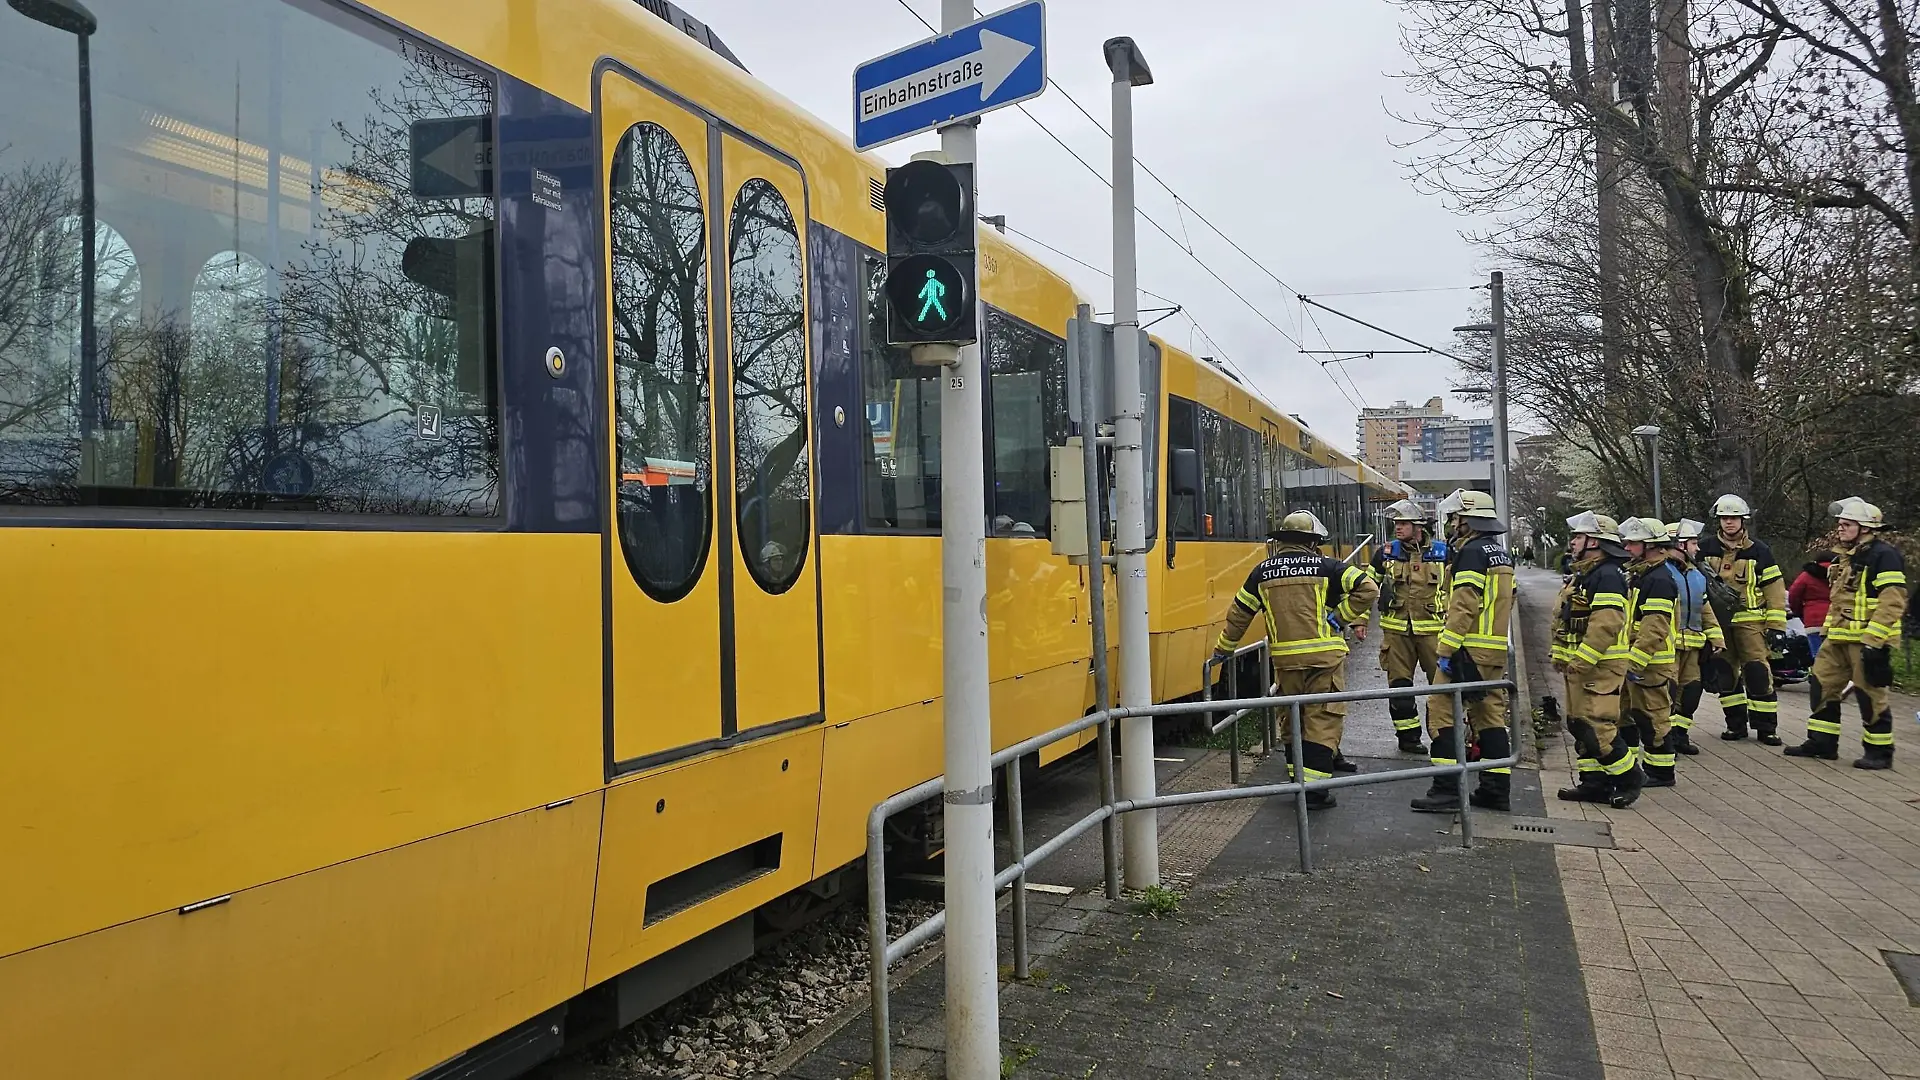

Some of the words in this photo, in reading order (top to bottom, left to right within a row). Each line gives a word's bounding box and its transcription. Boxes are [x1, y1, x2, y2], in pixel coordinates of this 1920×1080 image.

[864, 61, 983, 115] Einbahnstraße
[536, 170, 561, 188] Einsteigen
[951, 378, 963, 388] 25
[1260, 556, 1322, 568] FEUERWEHR
[1262, 566, 1320, 580] STUTTGART
